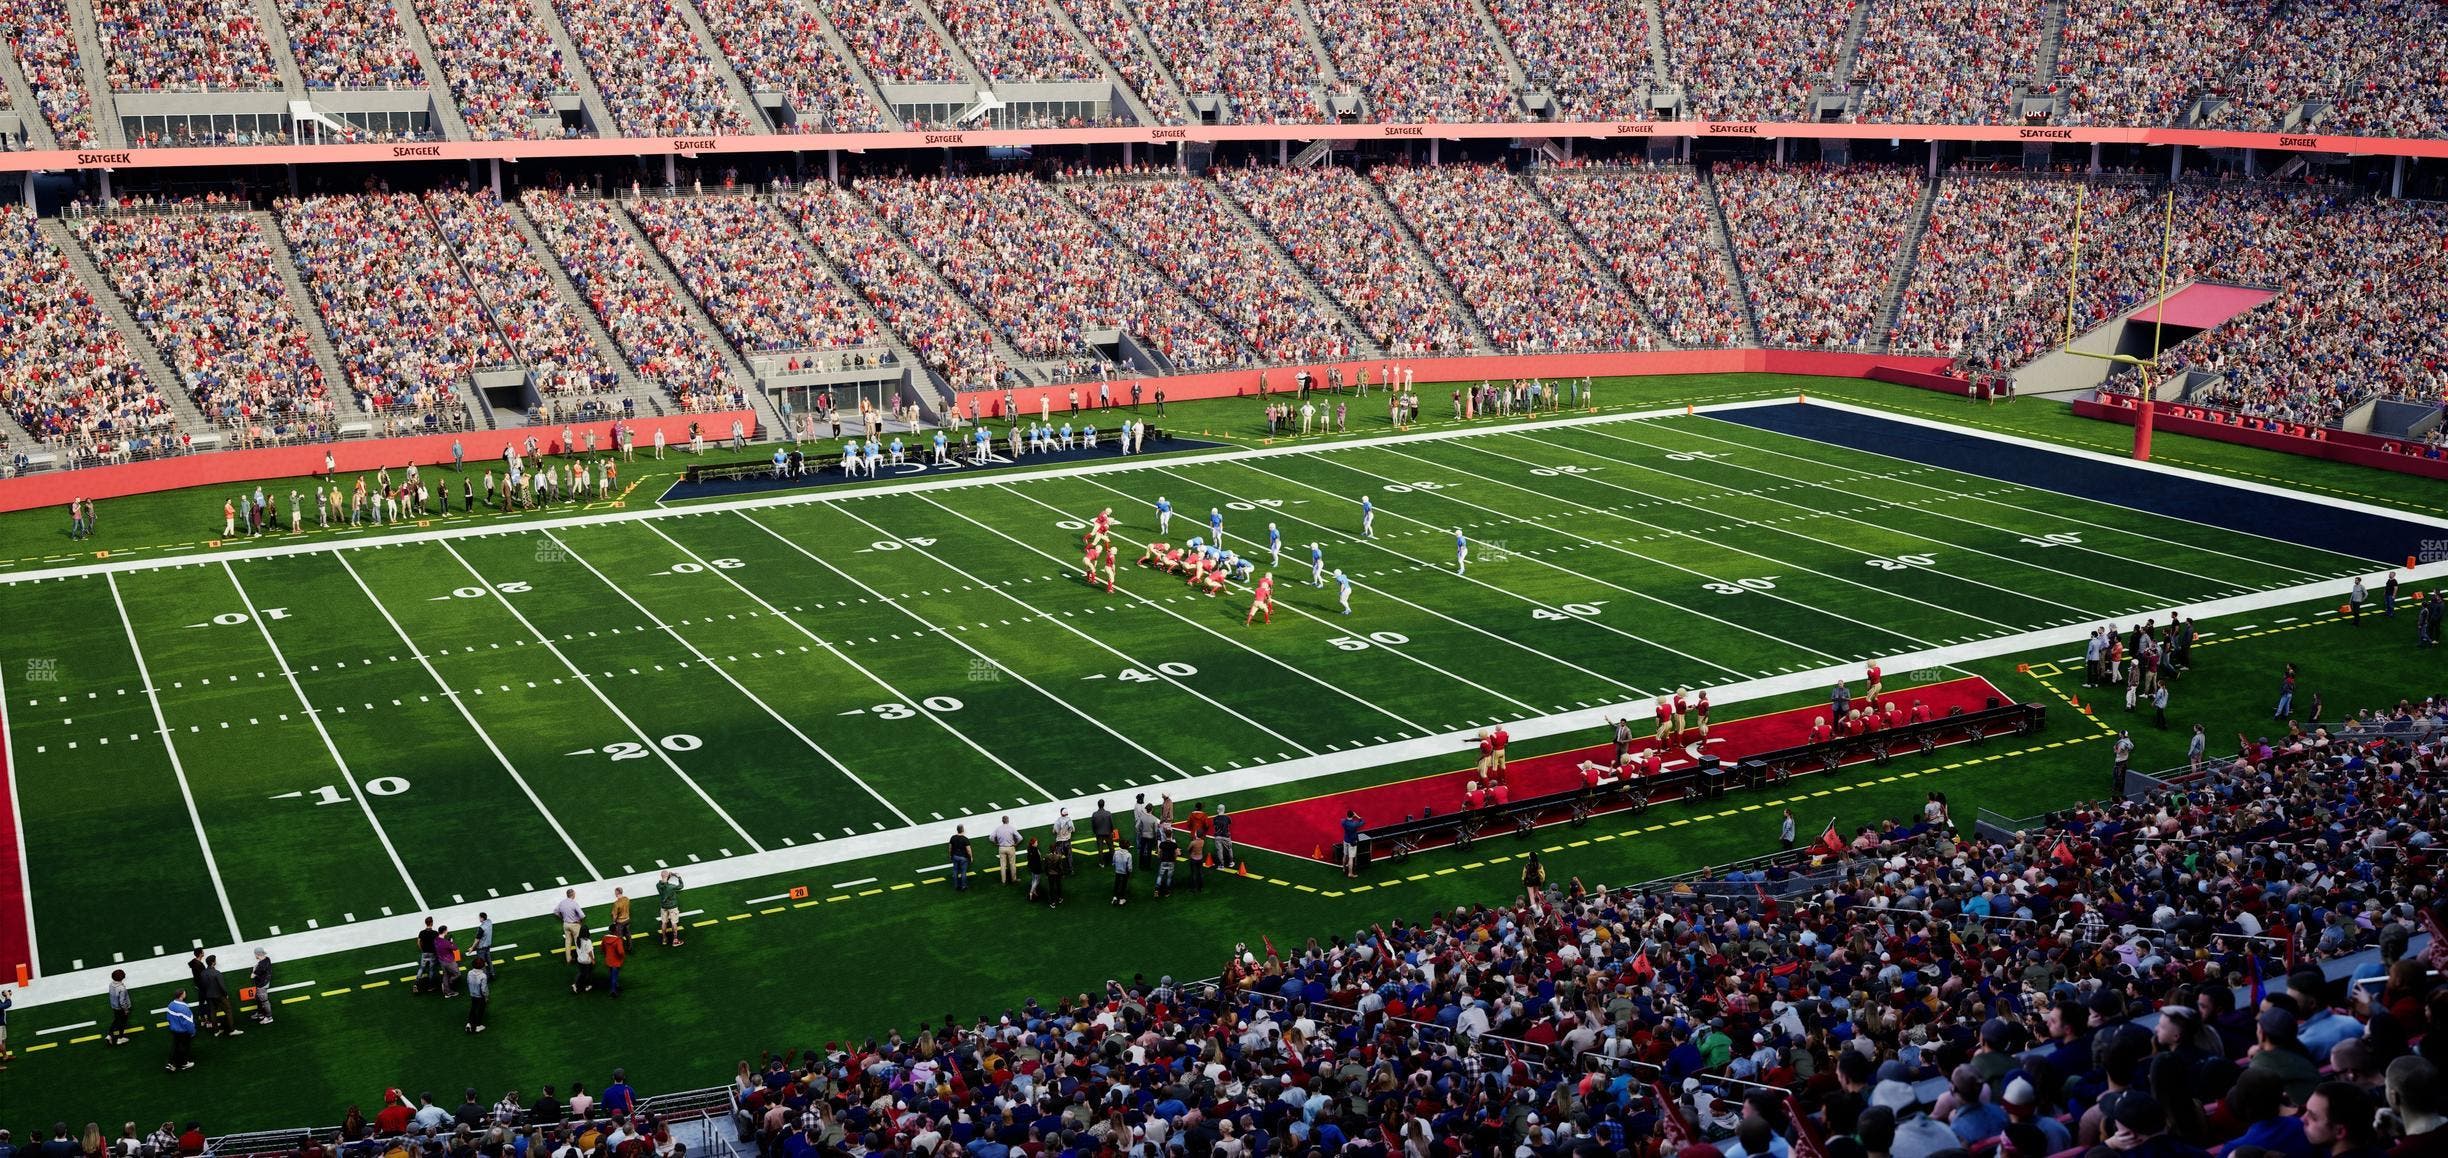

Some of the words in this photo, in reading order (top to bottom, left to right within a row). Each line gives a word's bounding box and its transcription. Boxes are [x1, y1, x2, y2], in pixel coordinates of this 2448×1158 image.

[1152, 129, 1186, 138] SEATGEEK
[1386, 127, 1423, 136] SEATGEEK
[1618, 125, 1654, 134] SEATGEEK
[1711, 125, 1757, 134] SEATGEEK
[2019, 129, 2073, 139] SEATGEEK
[675, 140, 716, 150] SEATGEEK
[925, 134, 963, 144] SEATGEEK
[2279, 136, 2317, 148] SEATGEEK
[394, 146, 440, 157] SEATGEEK
[78, 152, 131, 165] SEATGEEK
[1665, 451, 1718, 461] 10
[1530, 465, 1588, 476] 20
[1383, 481, 1445, 492] 30
[1226, 499, 1283, 510] 40
[871, 537, 938, 550] 40
[2019, 533, 2082, 548] 10
[671, 558, 746, 573] 30
[1865, 555, 1936, 571] 20
[453, 581, 533, 598] 20
[1702, 578, 1777, 595] 30
[213, 607, 292, 625] 10
[1532, 603, 1602, 621] 40
[1326, 631, 1410, 651] 50
[1117, 662, 1198, 683] 40
[871, 696, 964, 720] 30
[602, 734, 703, 761] 20
[309, 776, 411, 805] 10
